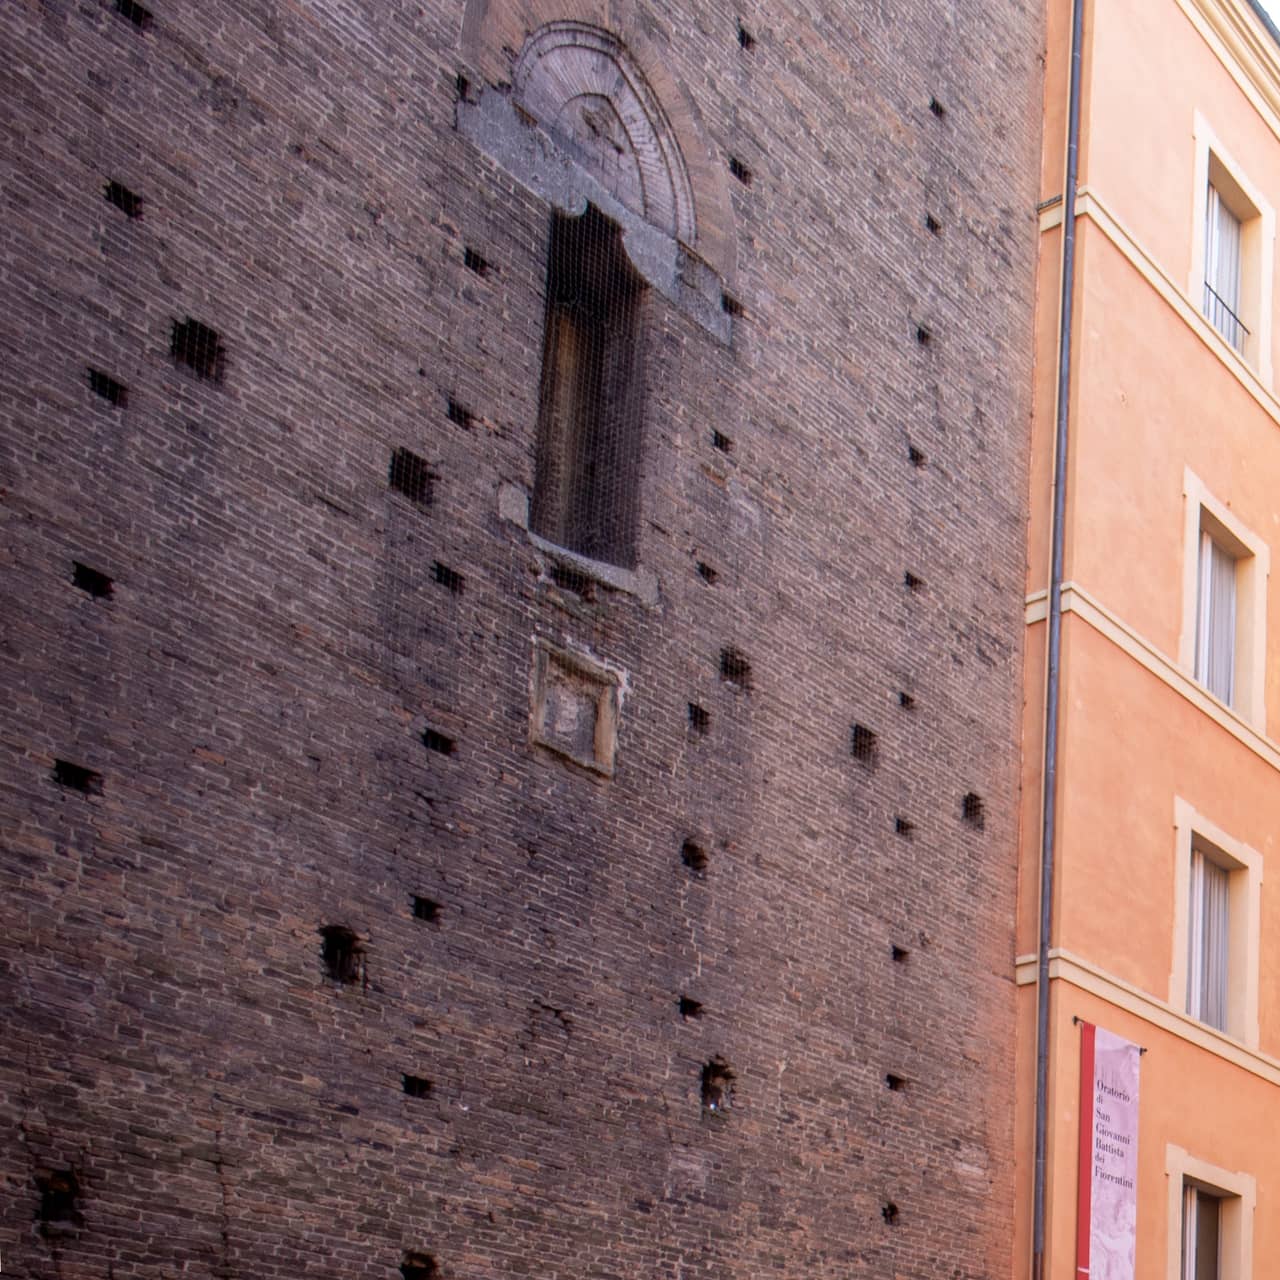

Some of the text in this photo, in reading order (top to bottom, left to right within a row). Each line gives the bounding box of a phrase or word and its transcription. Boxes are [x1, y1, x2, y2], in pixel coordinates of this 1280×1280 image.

[1096, 1080, 1130, 1102] Oratorio
[1096, 1094, 1103, 1104] di
[1096, 1108, 1110, 1122] San
[1095, 1123, 1130, 1144] Giovanni
[1095, 1138, 1124, 1157] Battista
[1095, 1153, 1104, 1163] dei
[1095, 1166, 1133, 1189] Fiorentini
